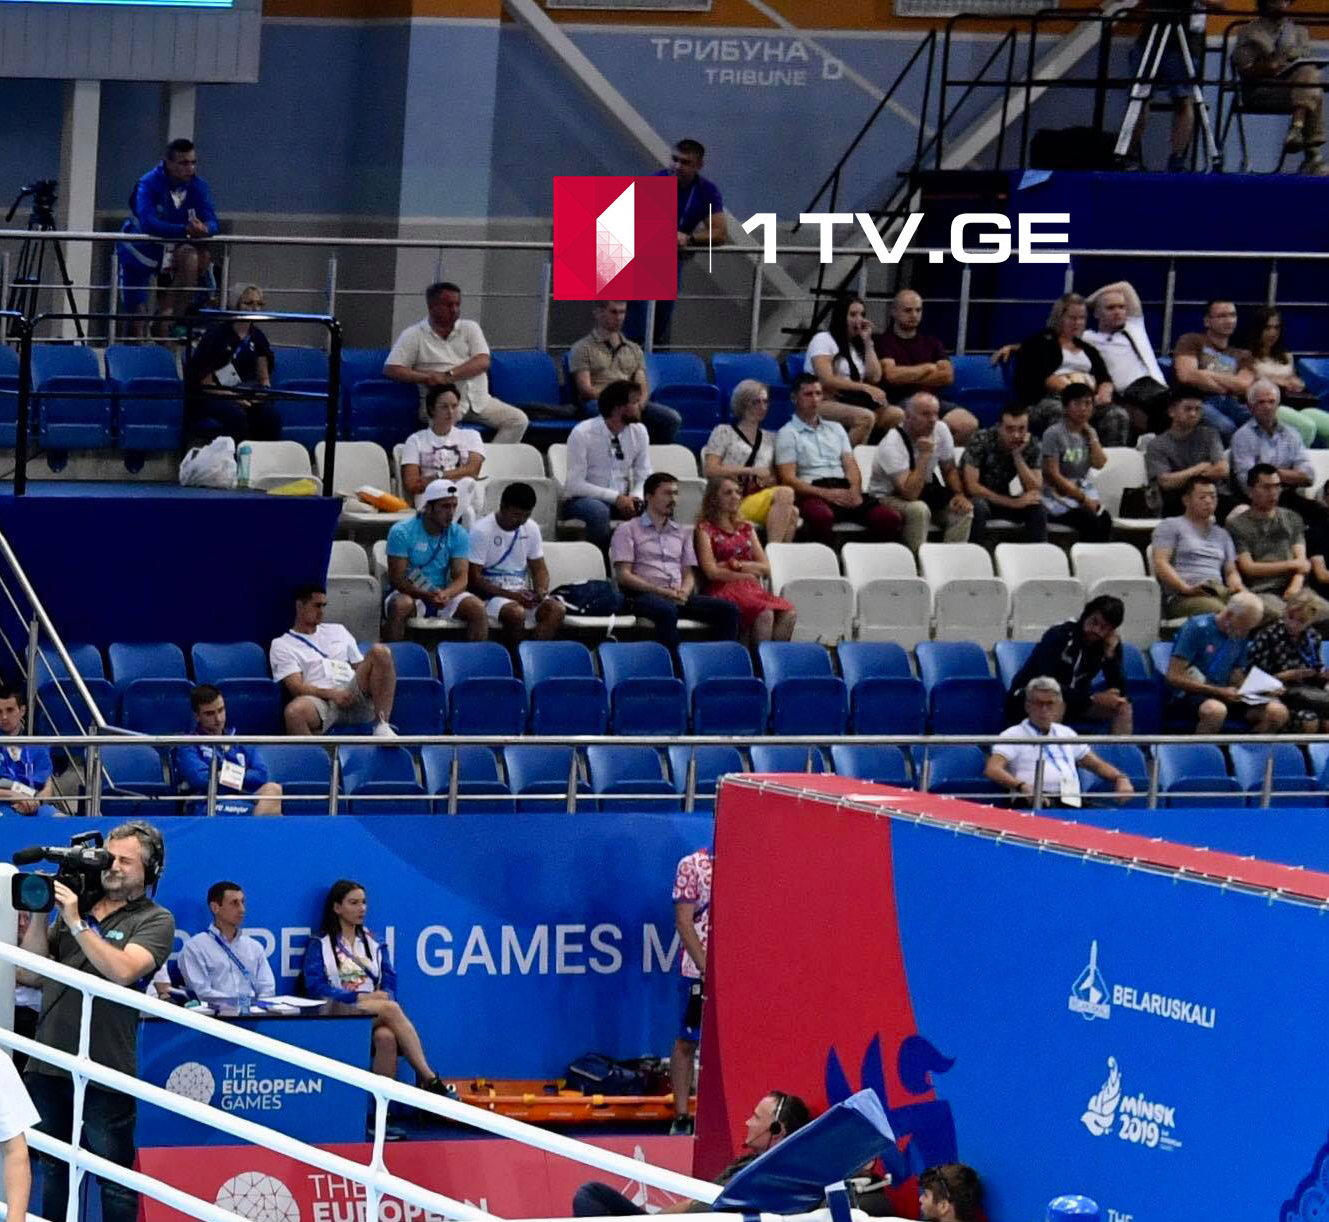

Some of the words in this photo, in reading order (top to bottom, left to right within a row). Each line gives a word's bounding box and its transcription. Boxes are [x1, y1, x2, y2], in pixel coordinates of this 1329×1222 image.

[651, 39, 809, 62] ТРИБУНА
[706, 70, 807, 86] TRIBUNE
[416, 924, 624, 976] GAMES
[1113, 985, 1216, 1029] BELARUSKALI
[223, 1064, 256, 1080] THE
[223, 1079, 323, 1095] EUROPEAN
[222, 1095, 283, 1111] GAMES
[1119, 1093, 1176, 1128] MINSK
[1119, 1115, 1161, 1148] 2019
